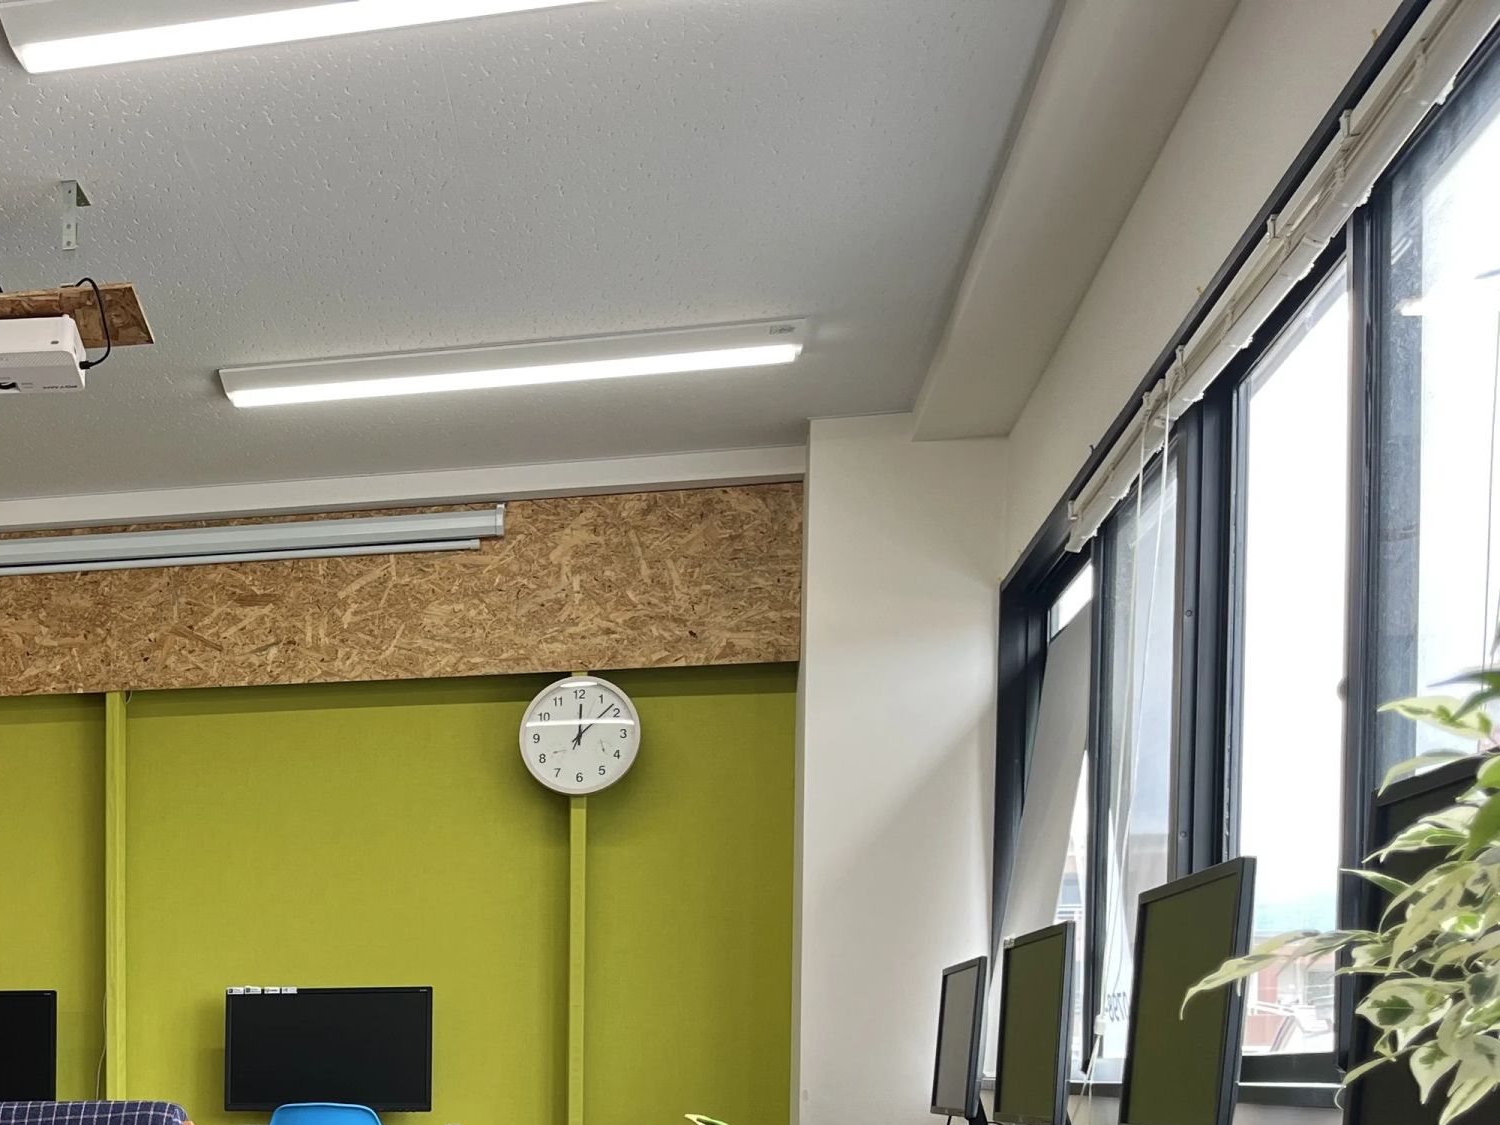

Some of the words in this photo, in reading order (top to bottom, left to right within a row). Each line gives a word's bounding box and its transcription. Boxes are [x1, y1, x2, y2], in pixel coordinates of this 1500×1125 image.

[573, 689, 586, 700] 12
[598, 694, 604, 704] 1
[553, 697, 563, 706] 11
[538, 712, 550, 721] 10
[612, 708, 620, 718] 2
[532, 733, 540, 743] 9
[619, 728, 627, 739] 3
[538, 753, 546, 763] 8
[613, 750, 620, 759] 4
[554, 767, 561, 777] 7
[598, 765, 606, 775] 5
[576, 772, 583, 783] 6
